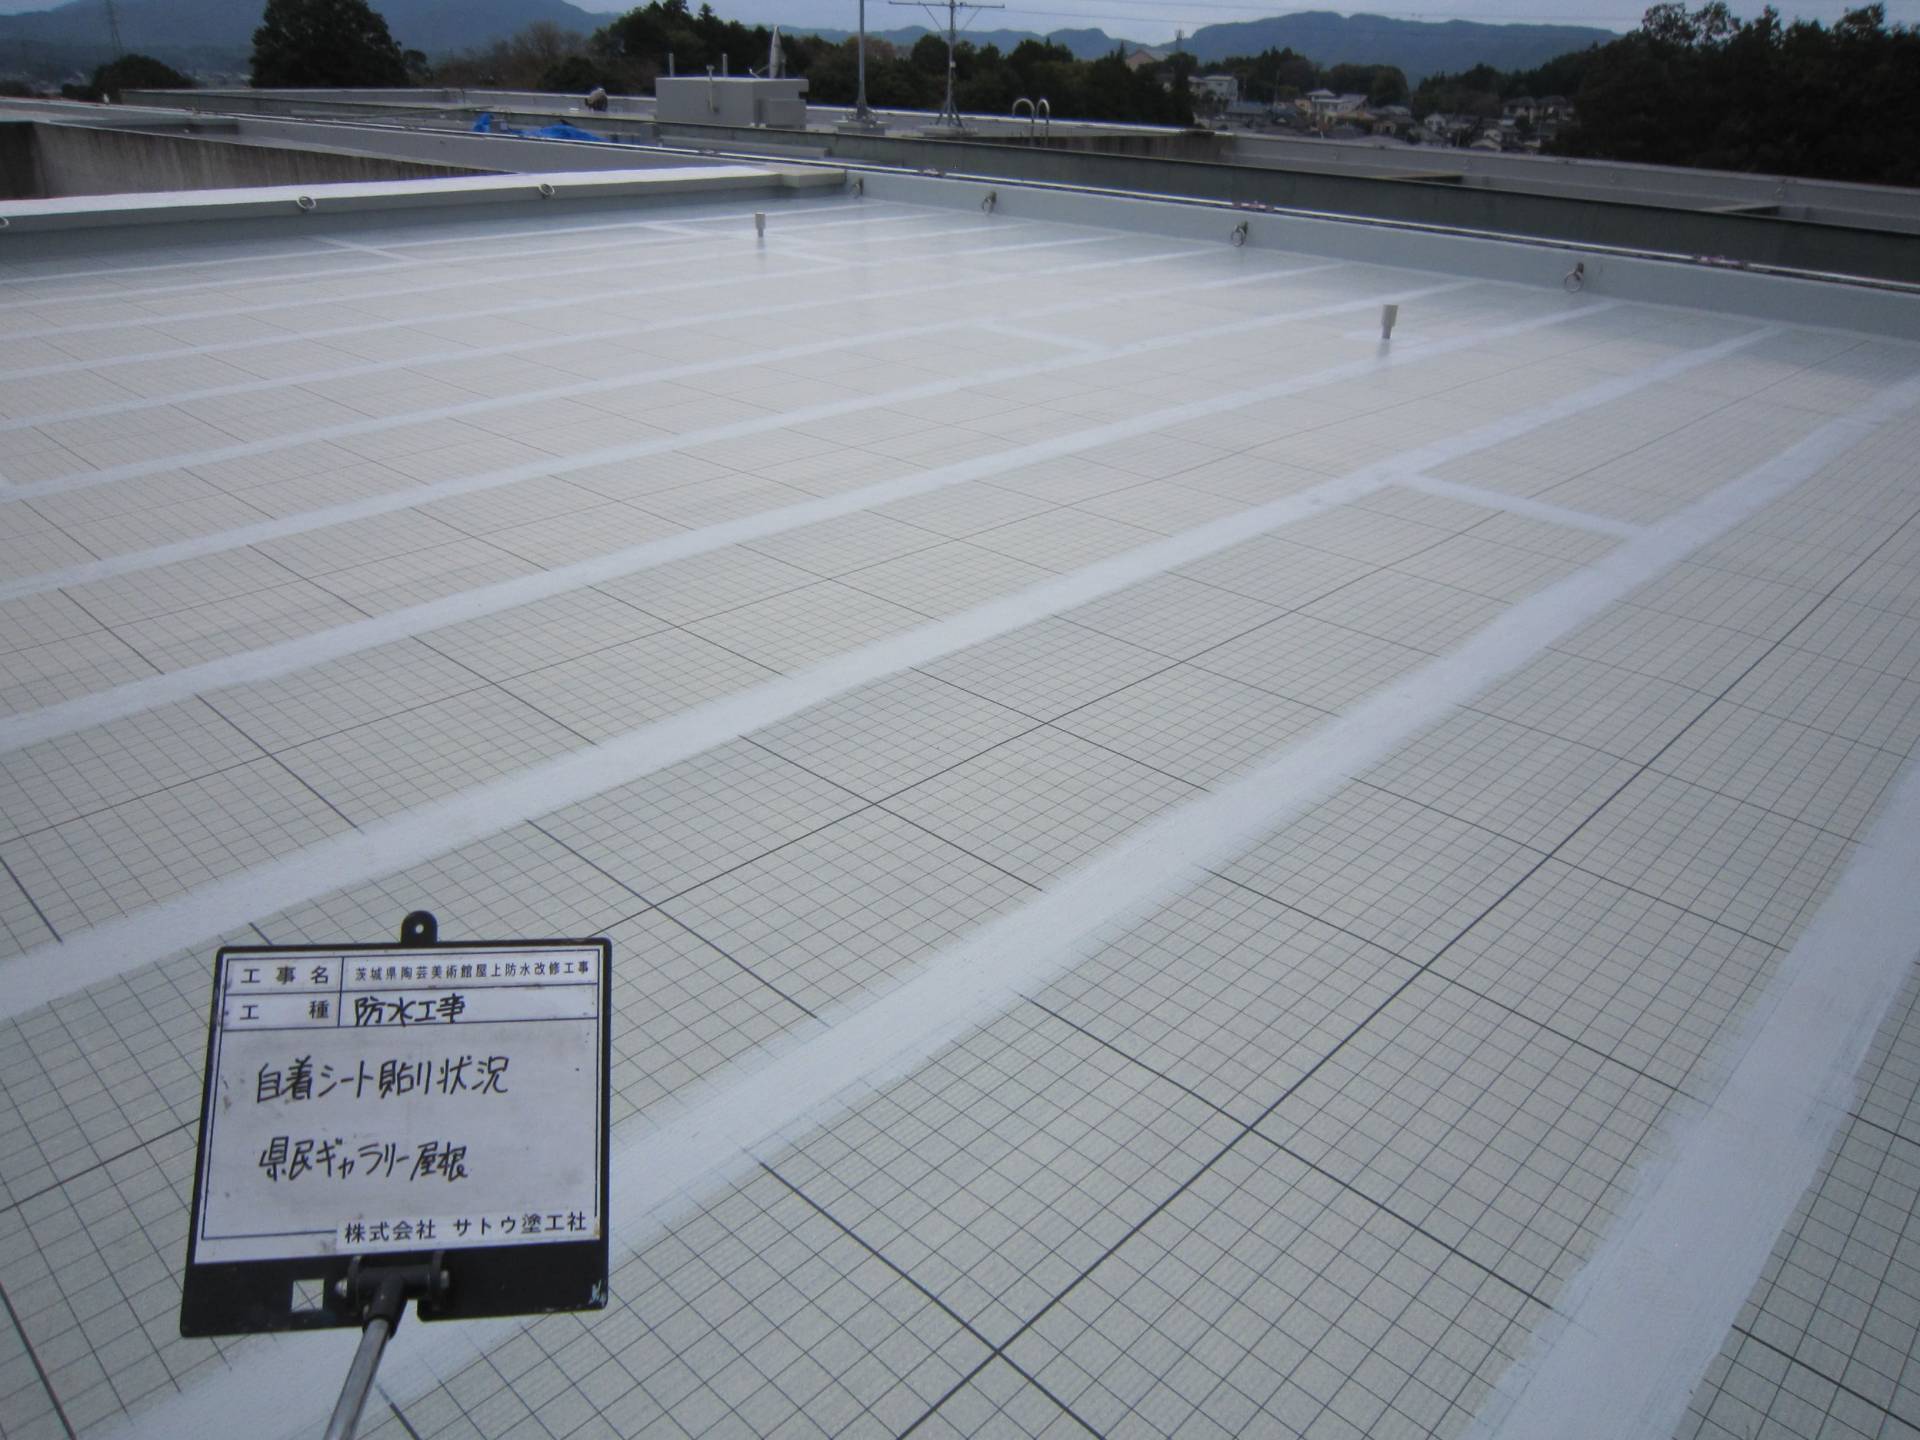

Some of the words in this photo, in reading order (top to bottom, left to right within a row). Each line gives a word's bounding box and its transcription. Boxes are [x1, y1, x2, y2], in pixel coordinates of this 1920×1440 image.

[240, 965, 330, 985] 工事名
[355, 960, 590, 981] 茨城県陶芸美術館屋上防水改修工事
[354, 993, 466, 1027] 防水工事
[258, 1135, 470, 1182] 県民ギャラリー屋根
[344, 1218, 437, 1242] 株式会社
[453, 1212, 587, 1236] サトウ塗工社
